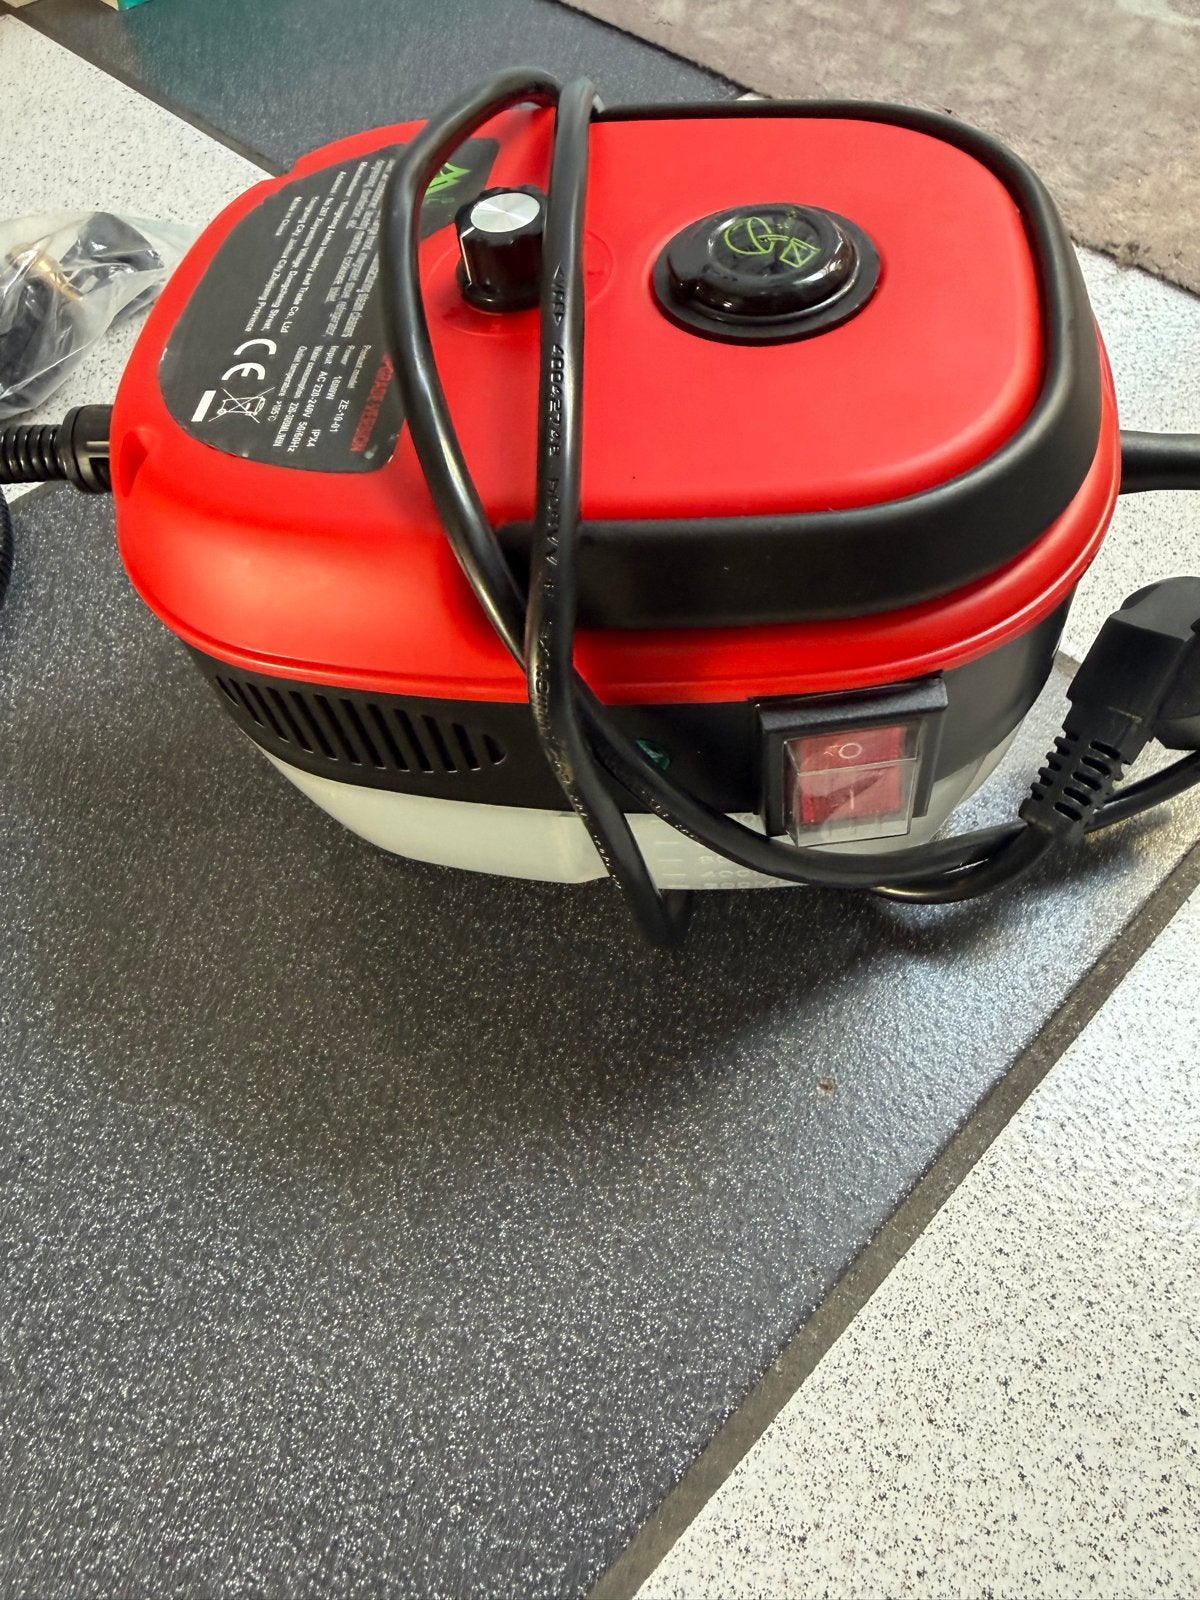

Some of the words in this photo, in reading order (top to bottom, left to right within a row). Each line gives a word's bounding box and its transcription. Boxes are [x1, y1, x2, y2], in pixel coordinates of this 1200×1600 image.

[301, 272, 314, 285] and
[291, 286, 309, 305] Trade
[243, 300, 267, 332] Province
[221, 339, 277, 381] CE
[323, 345, 339, 364] Input
[315, 370, 329, 382] AC
[300, 383, 324, 418] 220-240V
[328, 398, 350, 432] ZE-10-01
[285, 420, 309, 452] 50/60Hz
[305, 428, 321, 447] IPX4
